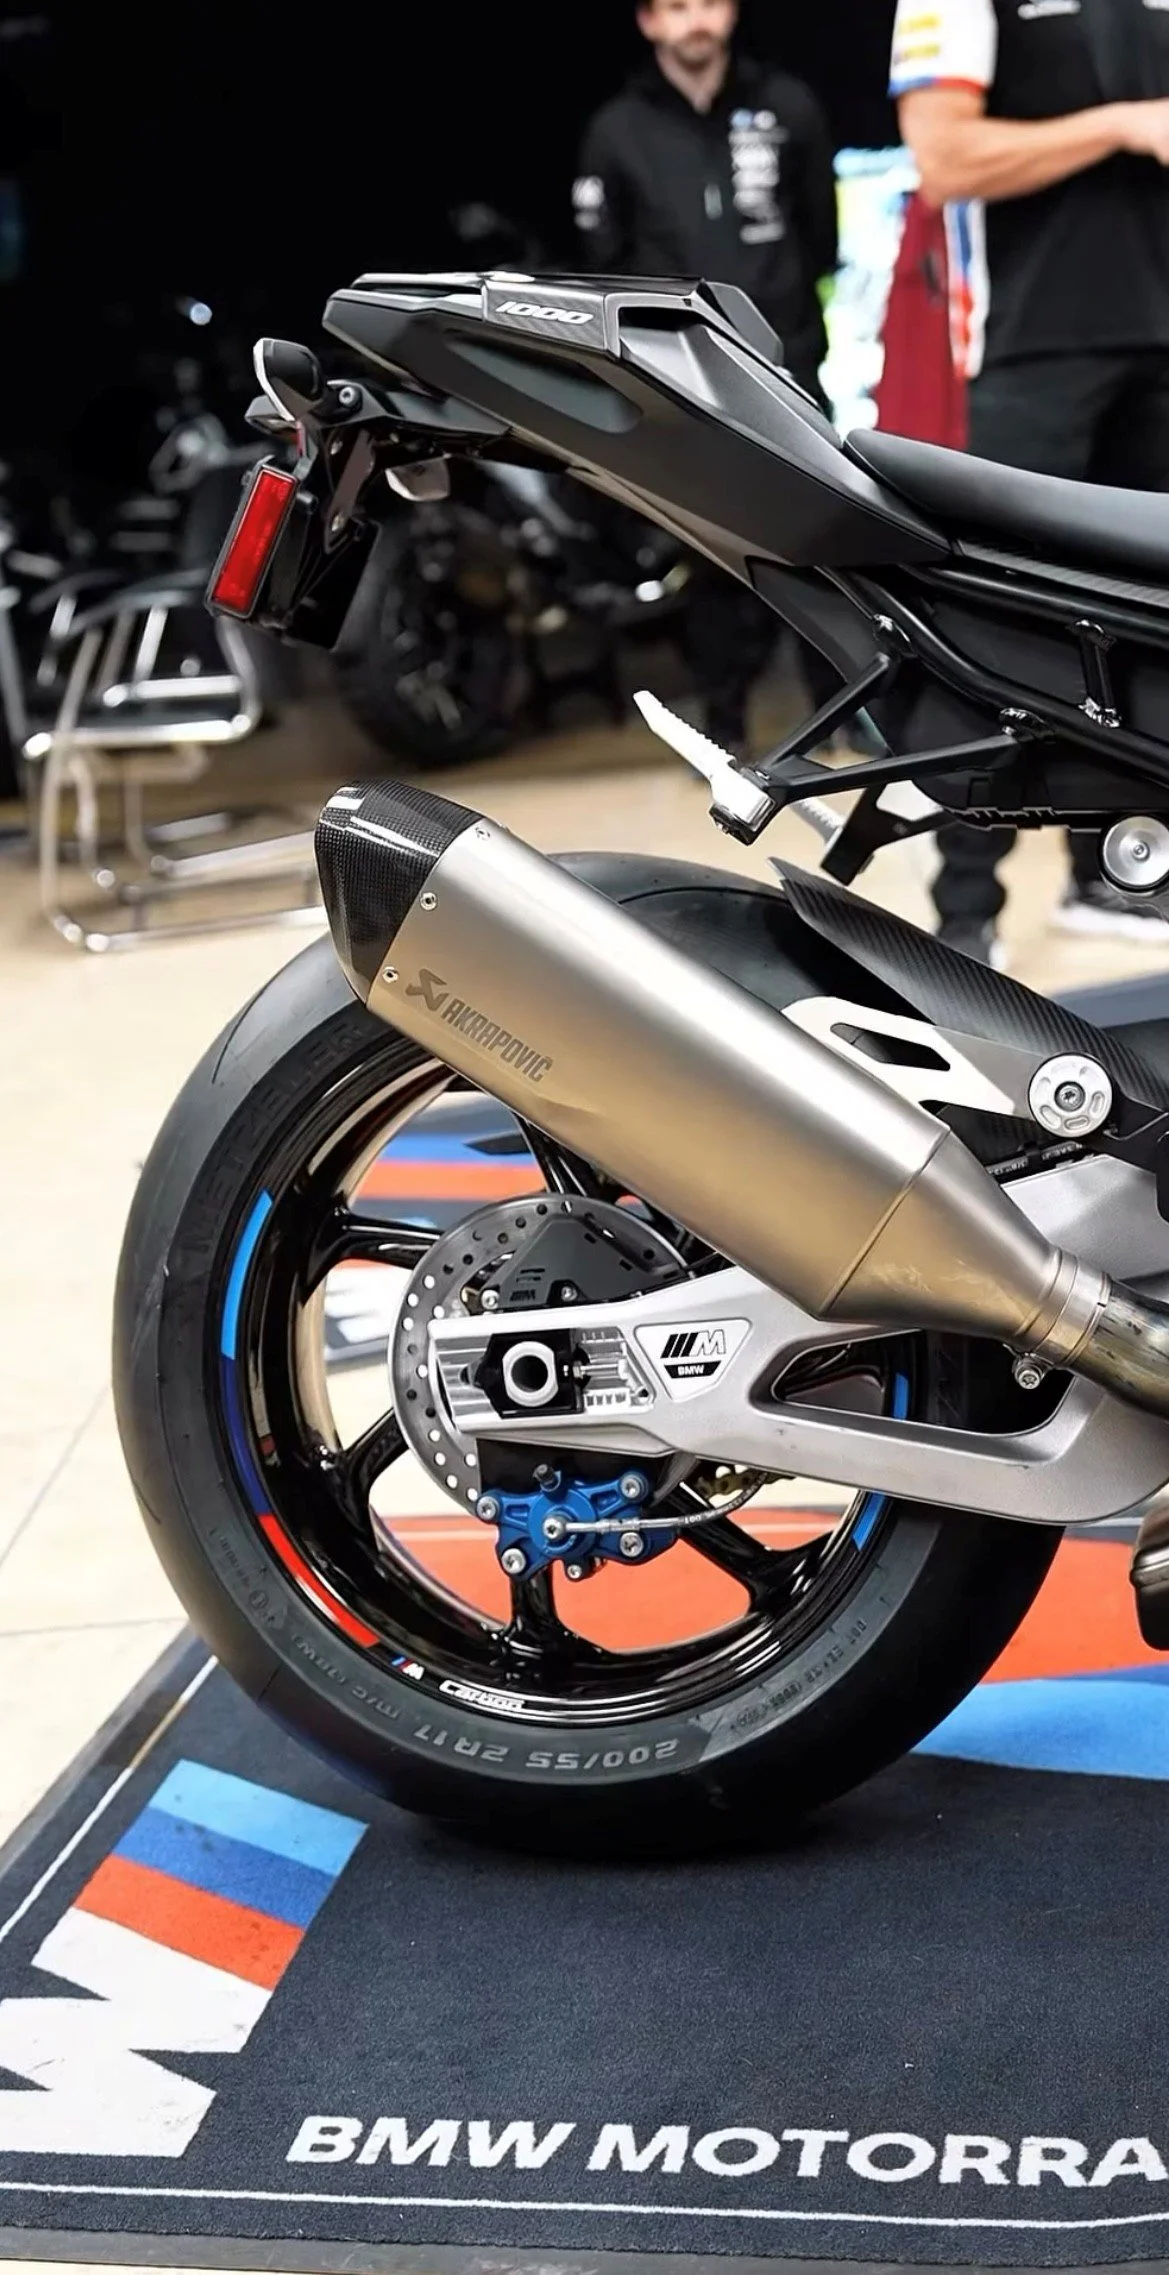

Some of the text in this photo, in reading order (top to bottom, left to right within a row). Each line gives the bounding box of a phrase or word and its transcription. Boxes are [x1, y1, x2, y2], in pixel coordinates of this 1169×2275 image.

[495, 301, 594, 324] 1000
[677, 1365, 705, 1376] BMW
[526, 1738, 681, 1771] 200/55
[286, 2115, 1168, 2187] BMW MOTORRA
